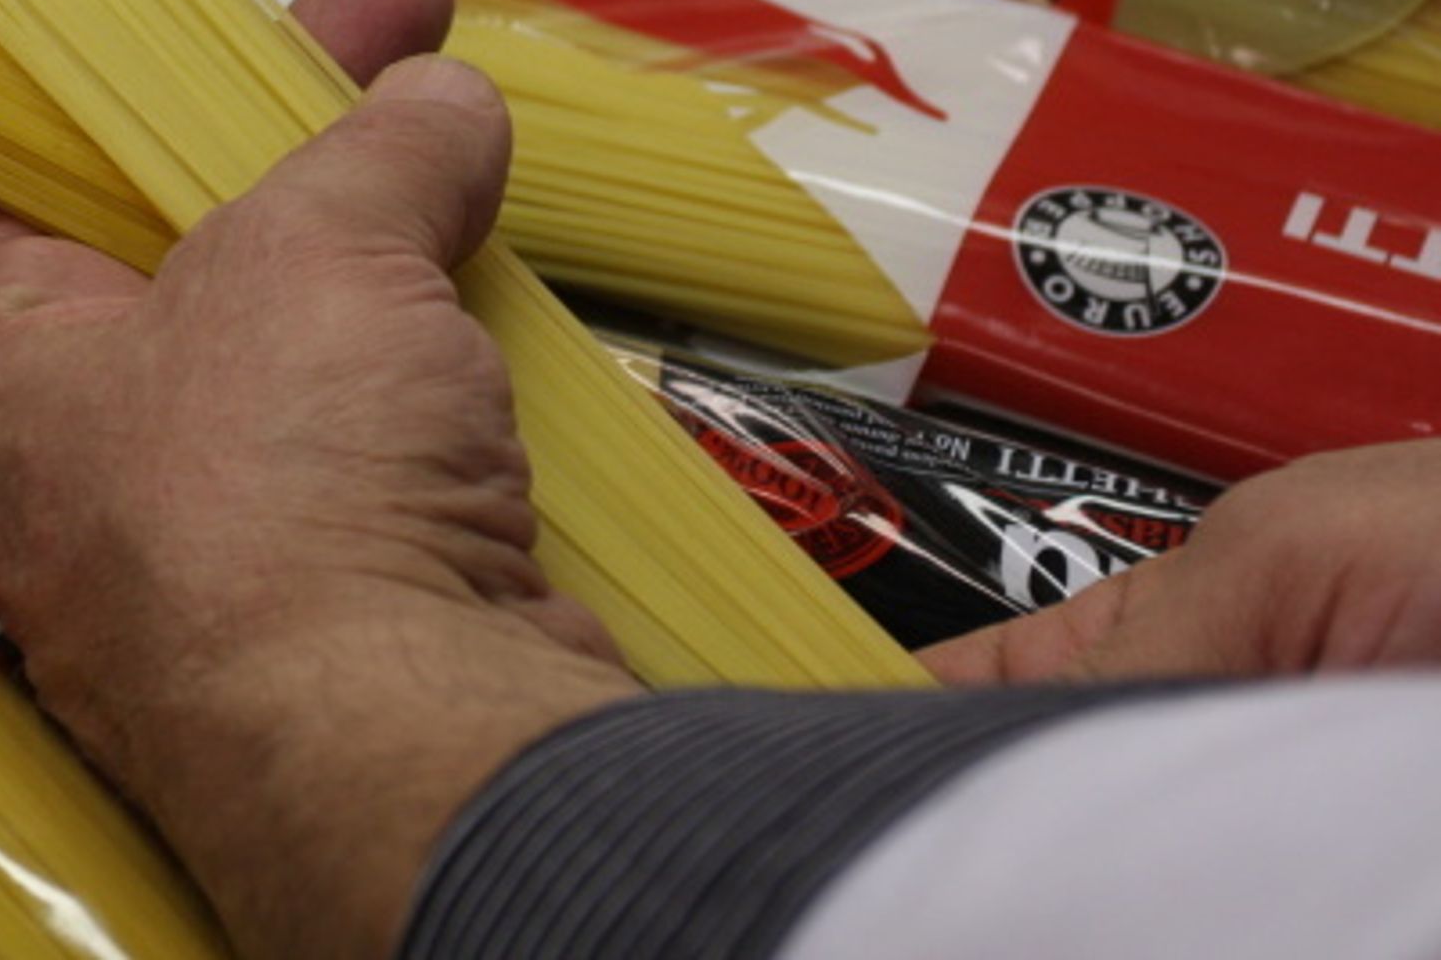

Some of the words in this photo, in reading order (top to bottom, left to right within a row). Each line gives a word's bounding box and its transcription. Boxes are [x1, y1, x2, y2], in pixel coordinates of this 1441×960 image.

[1023, 189, 1221, 266] SHOPPER
[1043, 274, 1188, 330] EURO
[996, 446, 1207, 508] HETTI
